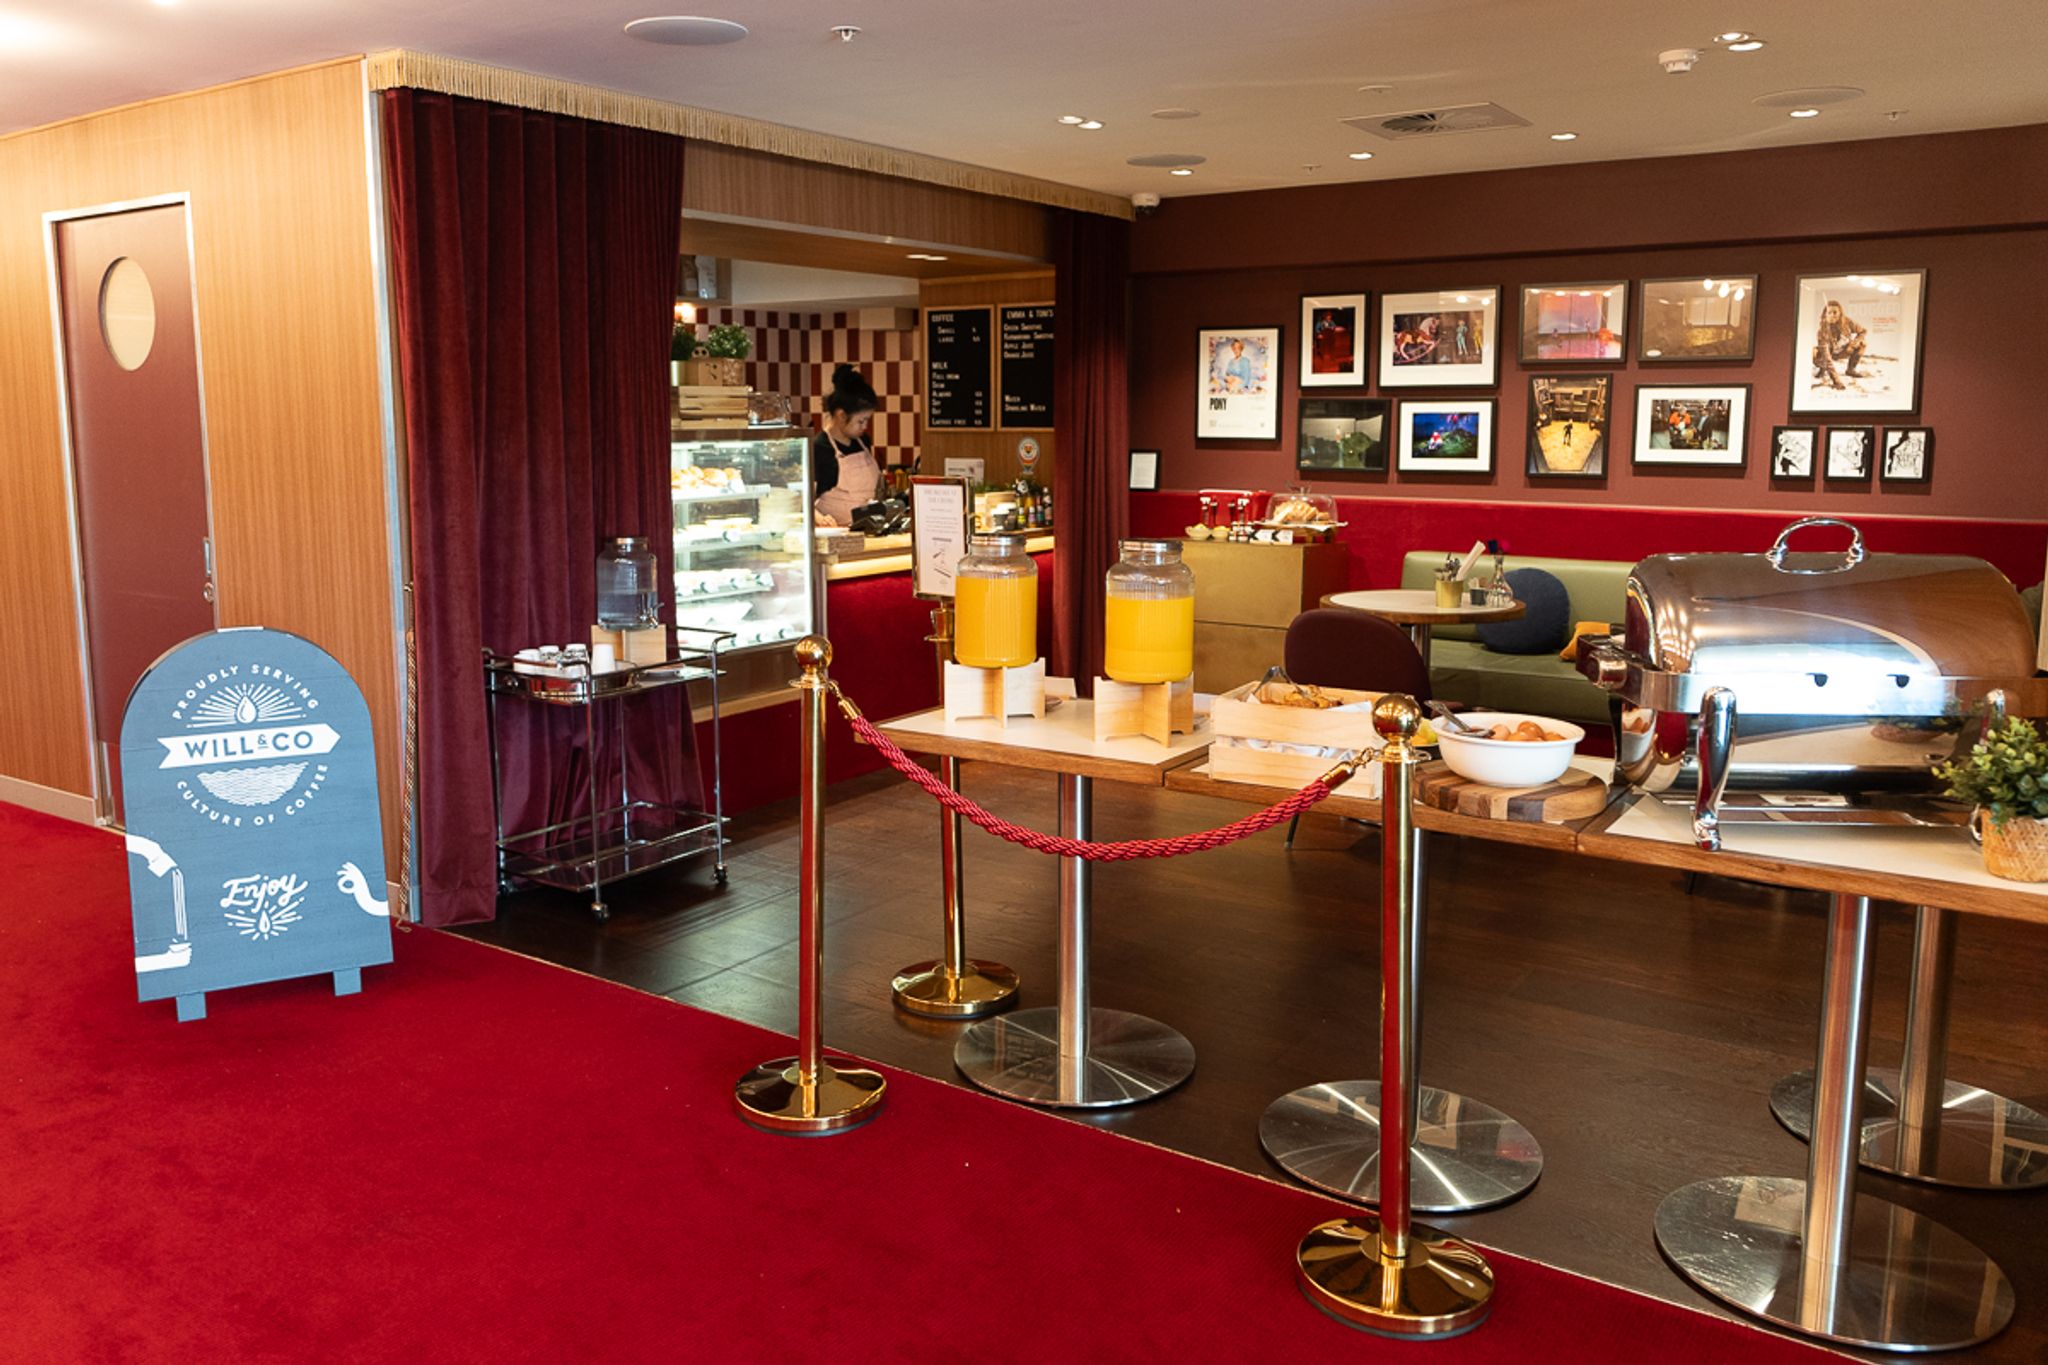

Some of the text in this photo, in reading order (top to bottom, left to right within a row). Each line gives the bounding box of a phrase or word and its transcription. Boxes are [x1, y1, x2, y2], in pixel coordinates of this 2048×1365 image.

[932, 314, 954, 322] COFFEE
[931, 361, 948, 370] MILK
[1209, 397, 1227, 410] PONY
[171, 663, 320, 720] PROUDLY SERVING
[176, 763, 329, 828] CULTURE OF COFFEE
[220, 872, 308, 912] Enjoy
